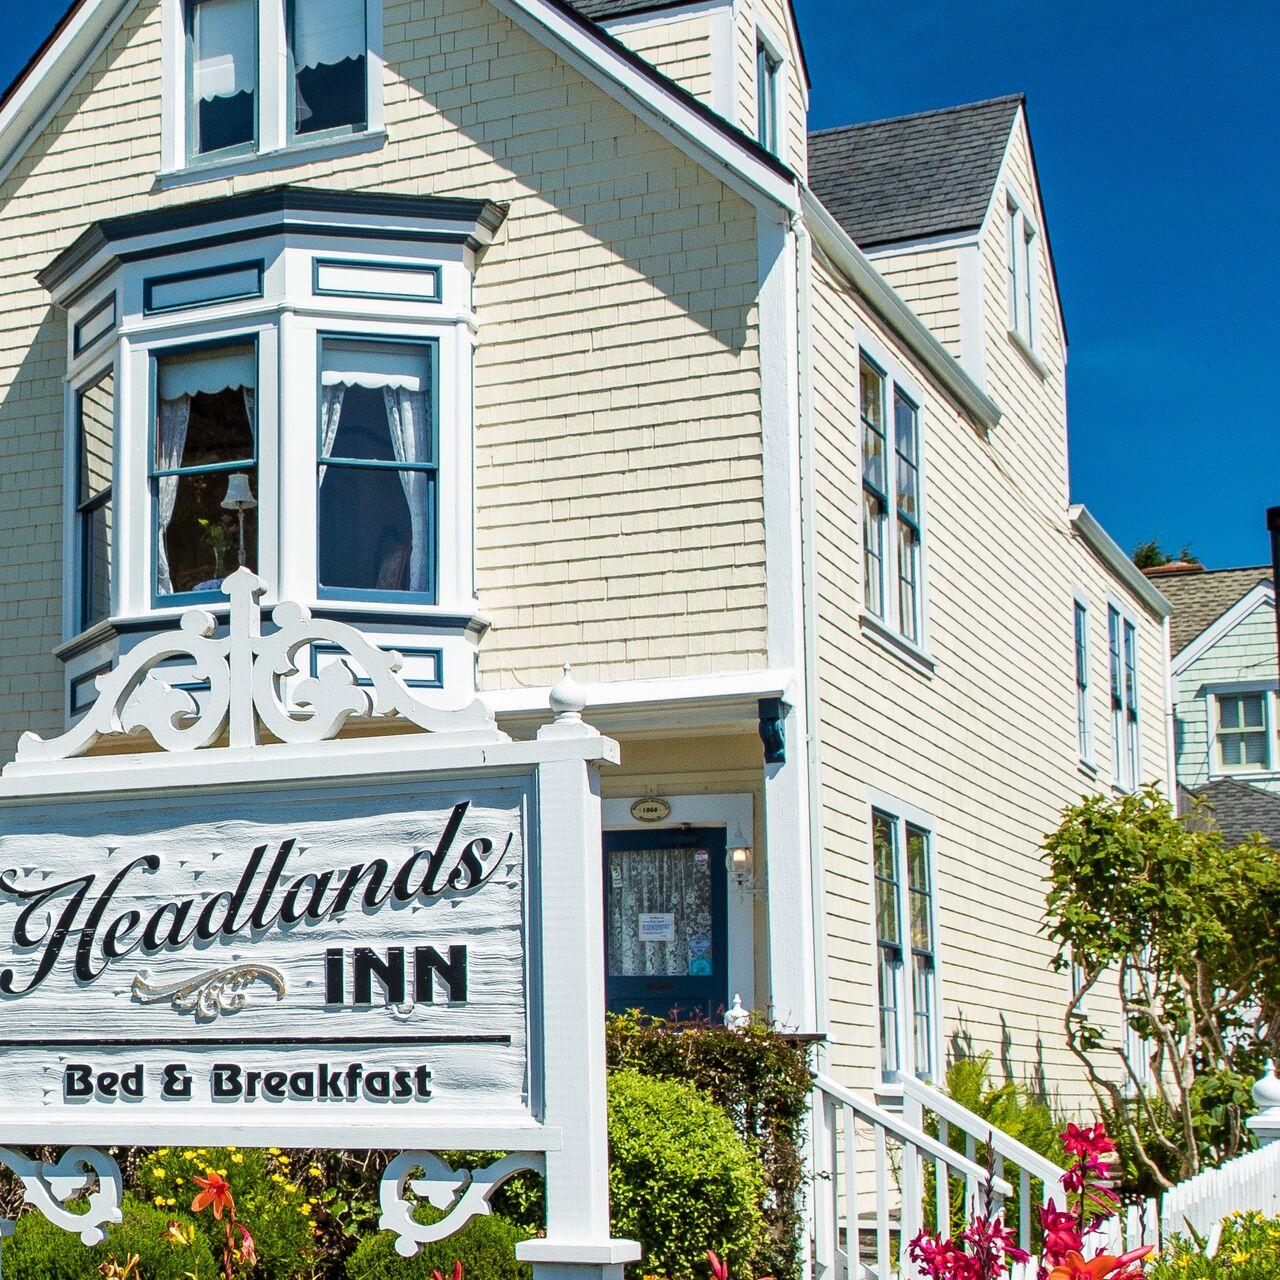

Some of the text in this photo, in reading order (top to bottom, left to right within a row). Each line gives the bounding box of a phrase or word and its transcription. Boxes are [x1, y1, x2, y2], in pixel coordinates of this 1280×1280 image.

[326, 944, 467, 1004] INN
[65, 1063, 432, 1097] Bed & Breakfast
